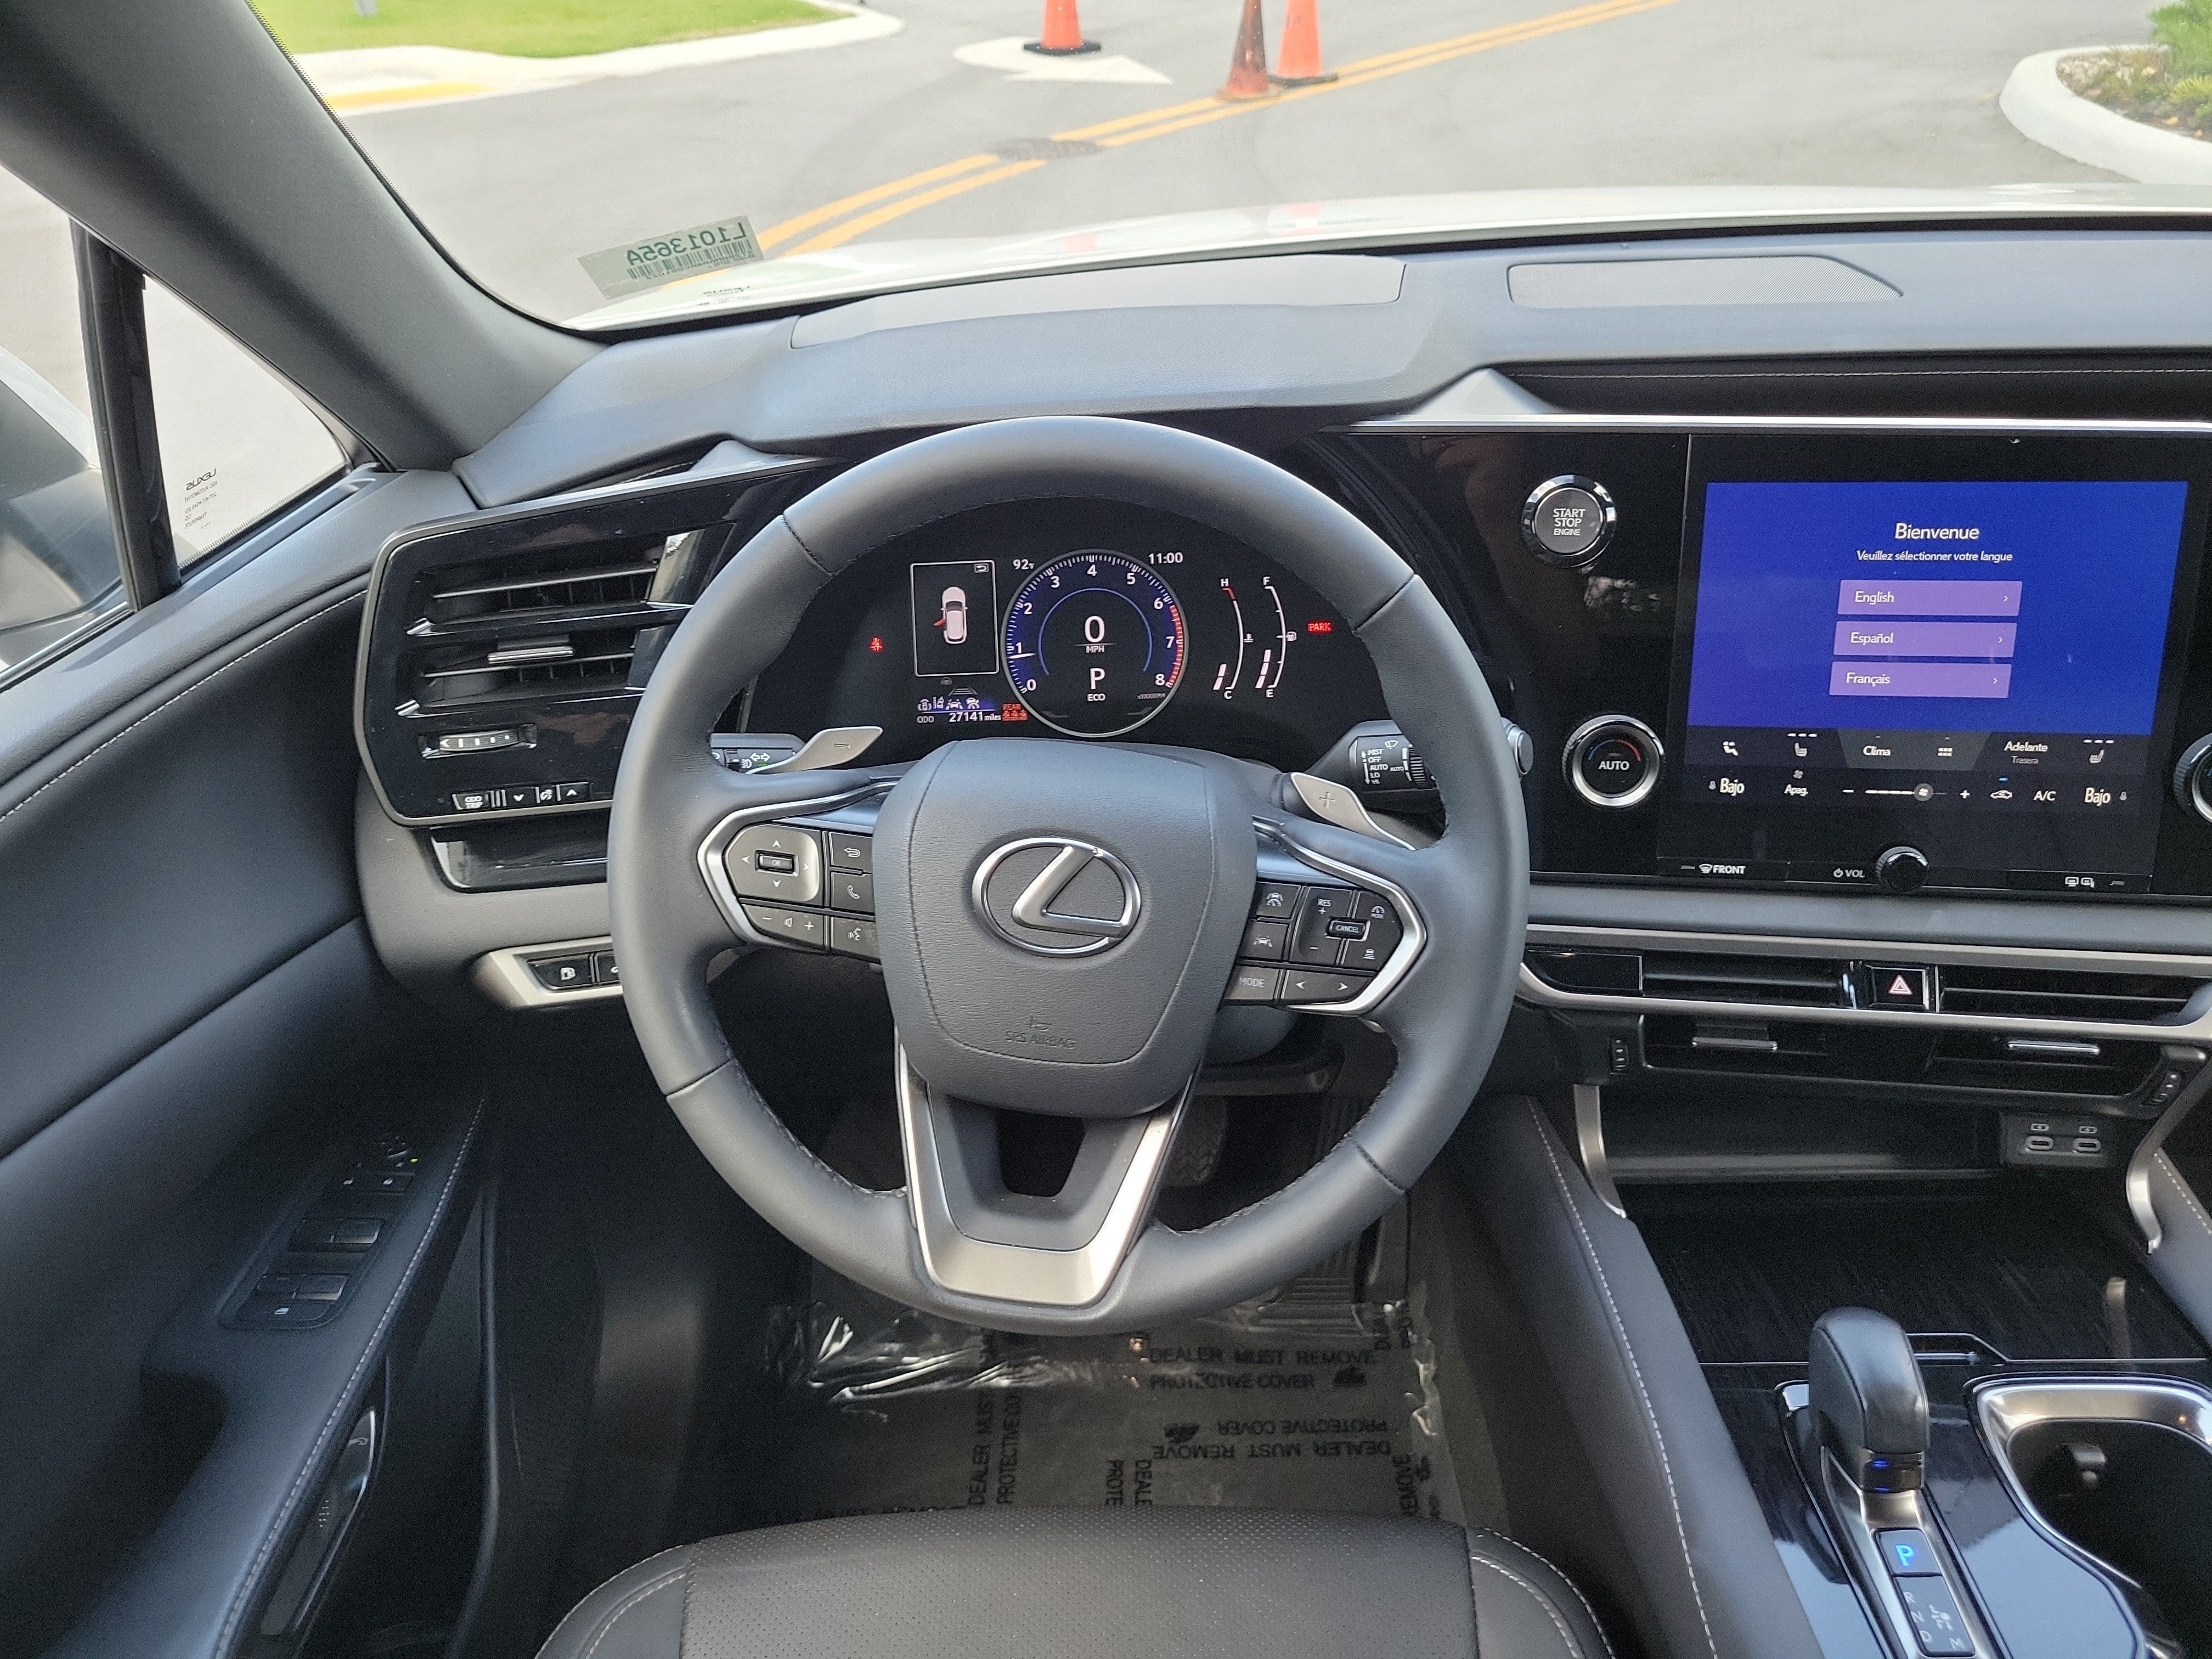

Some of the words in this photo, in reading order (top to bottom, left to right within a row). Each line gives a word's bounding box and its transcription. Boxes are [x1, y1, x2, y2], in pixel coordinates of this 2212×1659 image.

[1553, 508, 1585, 518] START
[1554, 517, 1582, 527] STOP
[1894, 523, 1979, 539] Bienvenue
[1148, 552, 1183, 564] 11:00
[1857, 550, 1893, 561] Veuillez
[1894, 551, 1952, 561] sélectionner
[1954, 552, 1978, 561] votre
[1980, 551, 2013, 563] langue
[1087, 565, 1098, 576] 4
[1051, 576, 1060, 588] 3
[1127, 573, 1136, 585] 5
[1220, 578, 1229, 587] H
[1263, 577, 1271, 585] F
[1154, 597, 1164, 609] 6
[1854, 591, 1894, 605] English
[1023, 602, 1032, 614] 2
[1084, 616, 1105, 642] 0
[1308, 623, 1331, 631] PARK
[1166, 636, 1175, 648] 7
[1850, 632, 1894, 645] Español
[1015, 642, 1022, 653] 1
[1026, 679, 1036, 691] 0
[1090, 668, 1105, 690] P
[1155, 674, 1165, 686] 8
[1846, 673, 1891, 687] Français
[1087, 693, 1105, 702] ECO
[1223, 691, 1232, 699] C
[1266, 689, 1273, 698] E
[949, 712, 983, 723] 27141
[1863, 746, 1891, 757] Clima
[2003, 741, 2048, 752] Adelante
[1598, 760, 1630, 770] AUTO
[2011, 755, 2039, 764] Trasera
[1719, 778, 1745, 796] Bajo
[2033, 790, 2056, 802] A/C
[2084, 788, 2111, 806] Bajo
[1712, 865, 1746, 874] FRONT
[1845, 869, 1865, 878] VOL
[1335, 924, 1359, 933] CANCEL
[1239, 977, 1265, 988] MODE
[1150, 1347, 1223, 1363] DEALER
[1233, 1349, 1284, 1365] MUST
[1297, 1350, 1376, 1364] REMOVE
[1258, 1374, 1314, 1389] COVER
[1217, 1419, 1276, 1435] COVER
[1282, 1420, 1387, 1433] PROTECTIVE
[1152, 1445, 1236, 1460] REMOVE
[1247, 1442, 1302, 1457] MUST
[1313, 1440, 1391, 1456] DEALER
[996, 1415, 1020, 1504] PROTECTIVE
[968, 1444, 991, 1505] DEALER
[1135, 1459, 1152, 1506] DEALE
[1895, 1545, 1914, 1566] P
[1904, 1592, 1915, 1603] R
[1910, 1611, 1924, 1622] N
[1920, 1630, 1933, 1643] D
[1949, 1638, 1966, 1649] M
